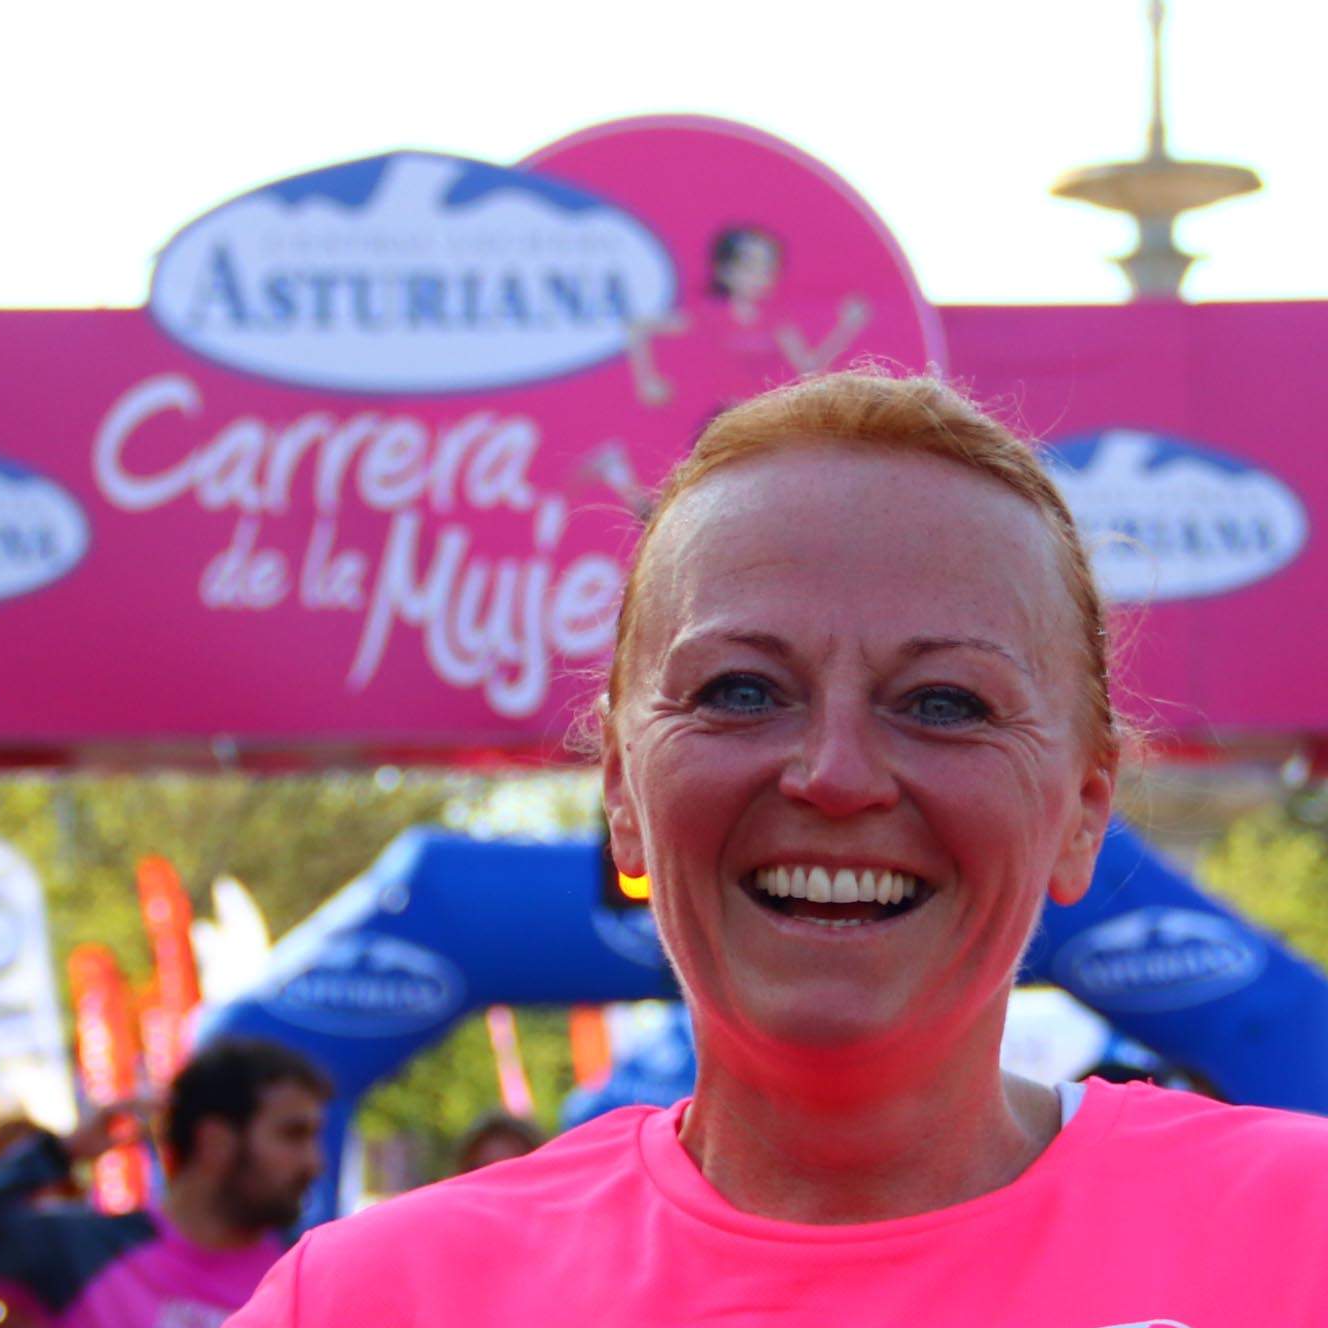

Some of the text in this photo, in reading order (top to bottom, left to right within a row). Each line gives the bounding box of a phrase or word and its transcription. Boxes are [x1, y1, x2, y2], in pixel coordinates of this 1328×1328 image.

[188, 238, 645, 334] ASTURIANA
[93, 373, 539, 516] Carrera
[199, 497, 629, 716] de la Muje
